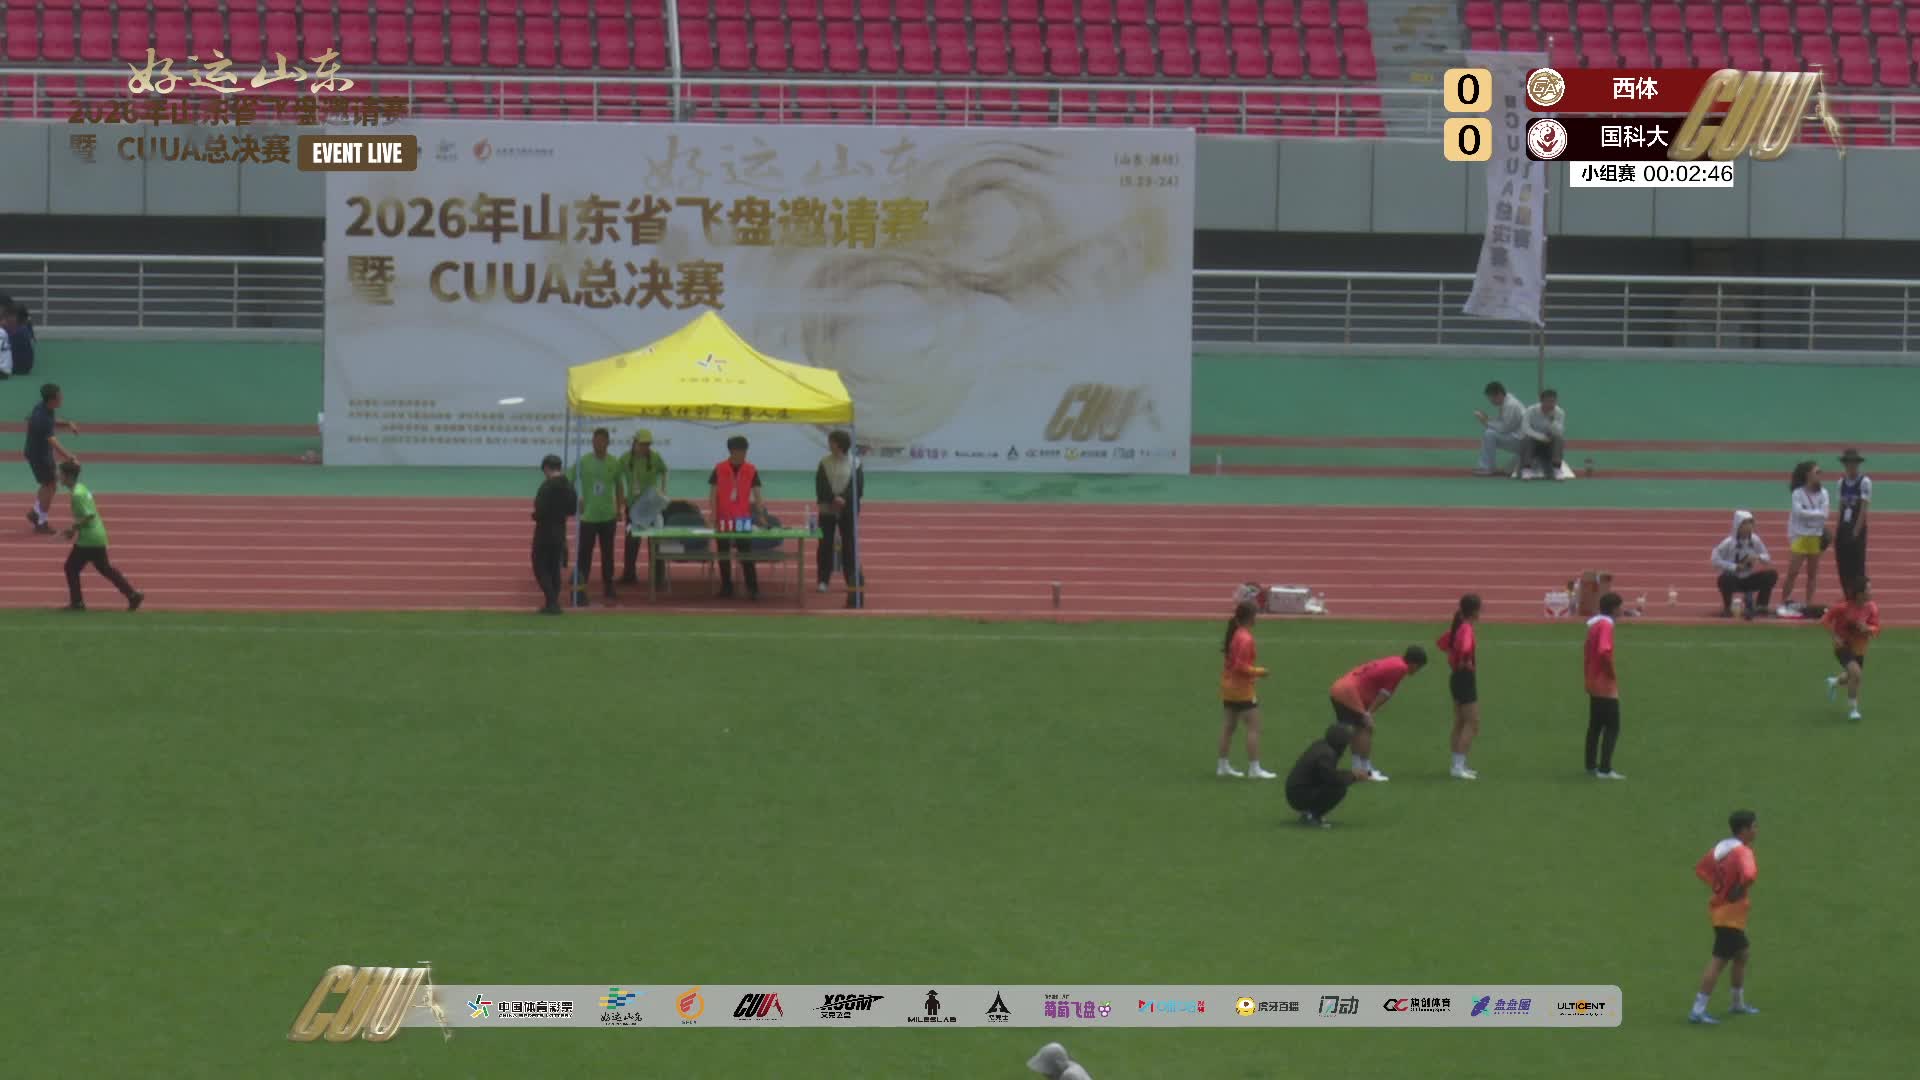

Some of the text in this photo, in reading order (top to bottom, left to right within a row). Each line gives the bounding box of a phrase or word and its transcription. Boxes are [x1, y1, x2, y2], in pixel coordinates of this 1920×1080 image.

[345, 192, 930, 249] 2026年山东省飞盘邀请赛
[347, 255, 725, 311] 暨 CUUA总决赛
